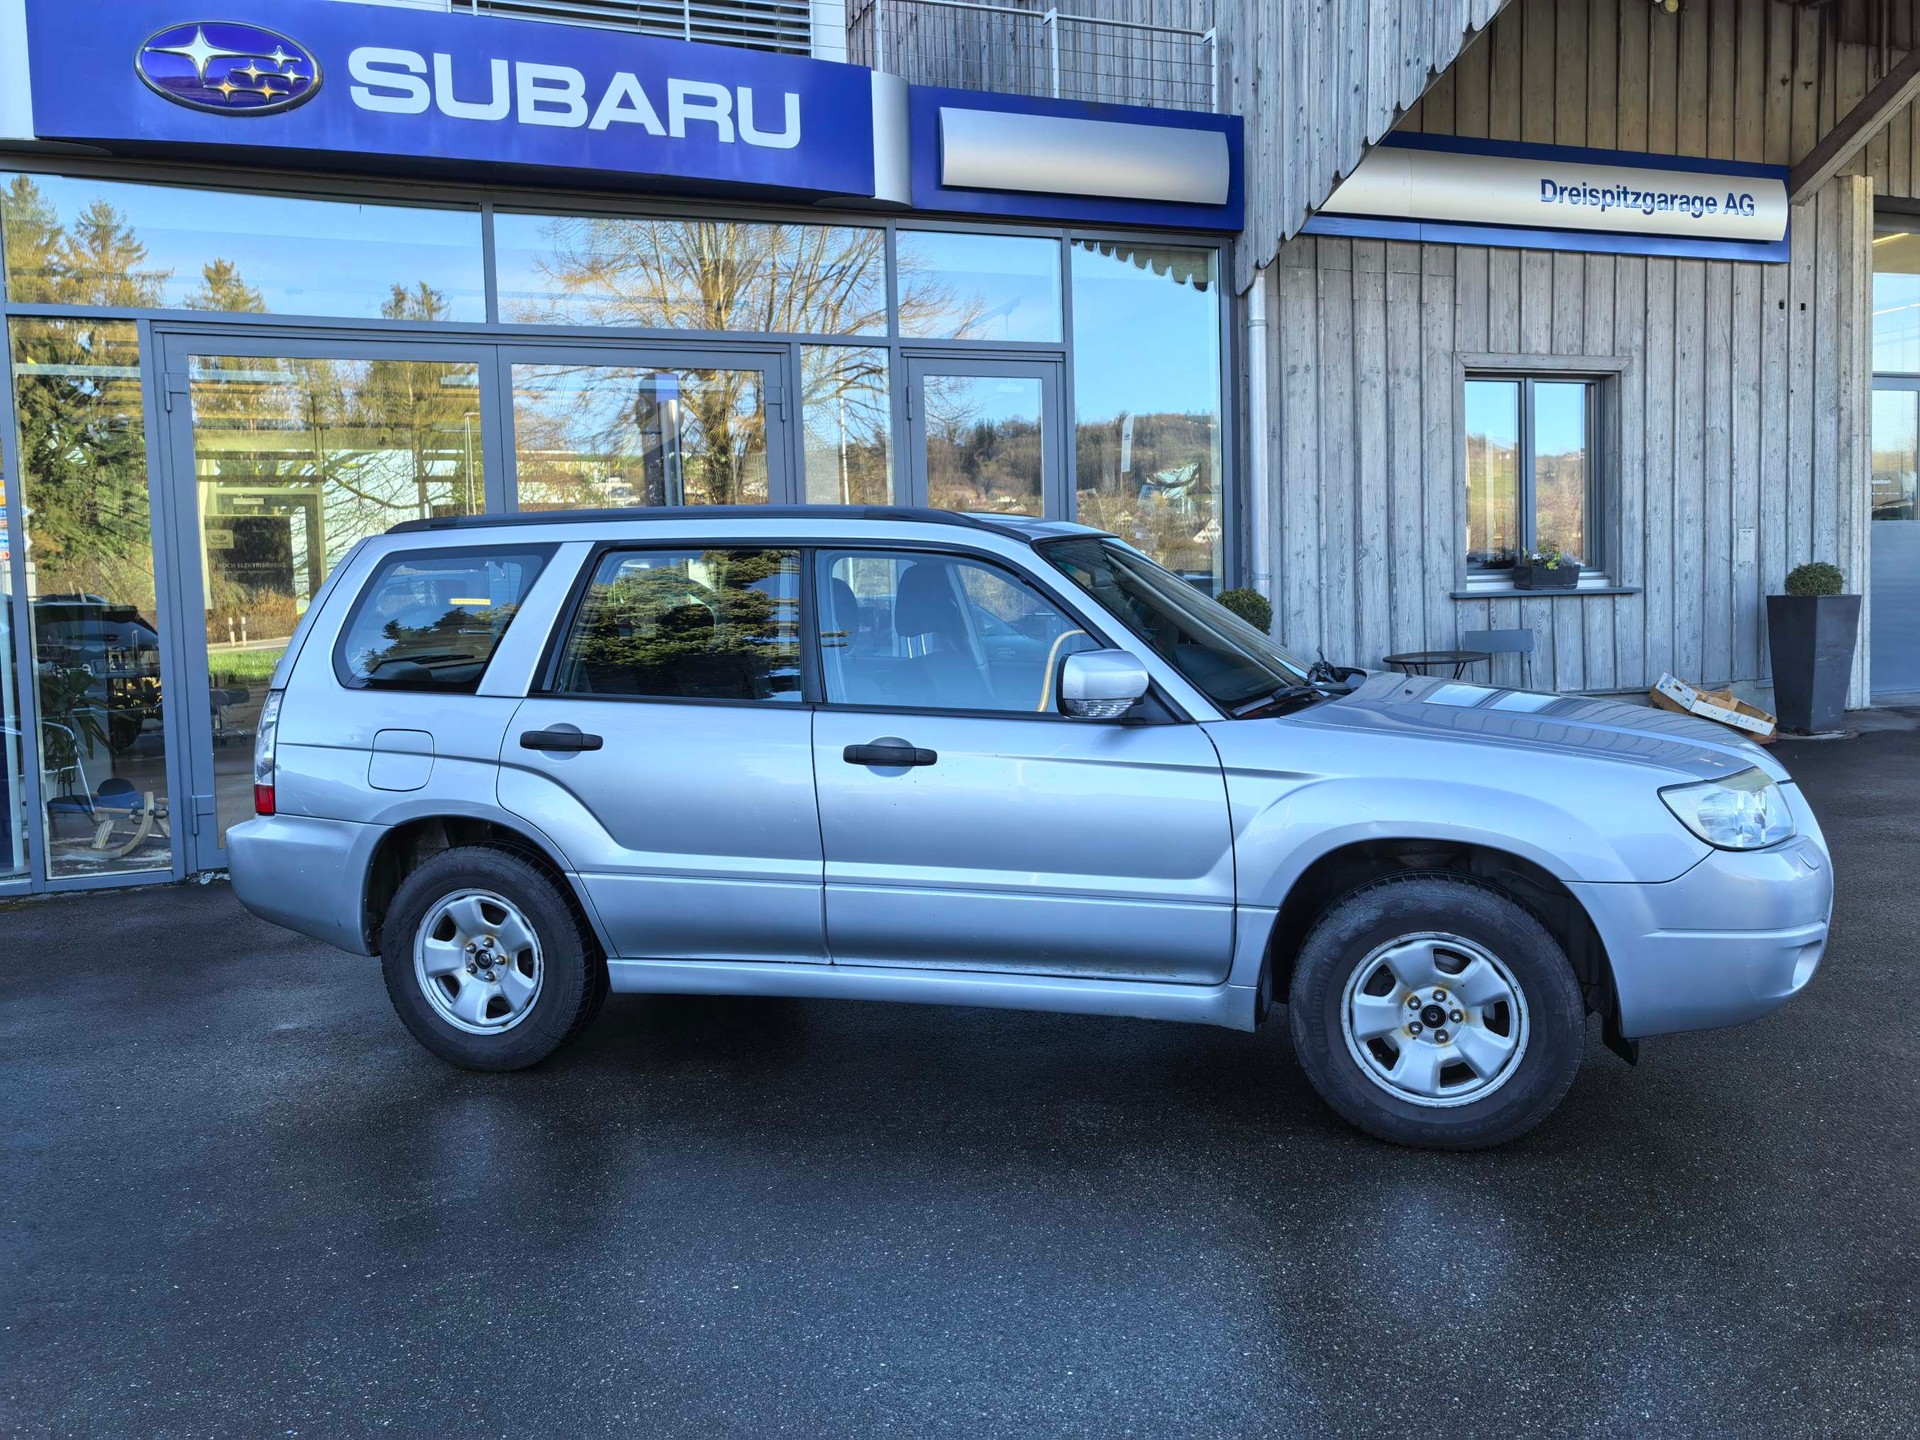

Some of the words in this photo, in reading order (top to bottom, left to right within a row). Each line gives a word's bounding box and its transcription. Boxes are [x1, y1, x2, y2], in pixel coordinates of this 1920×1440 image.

[348, 46, 800, 149] SUBARU
[1540, 178, 1718, 218] Dreispitzgarage
[1723, 192, 1755, 216] AG
